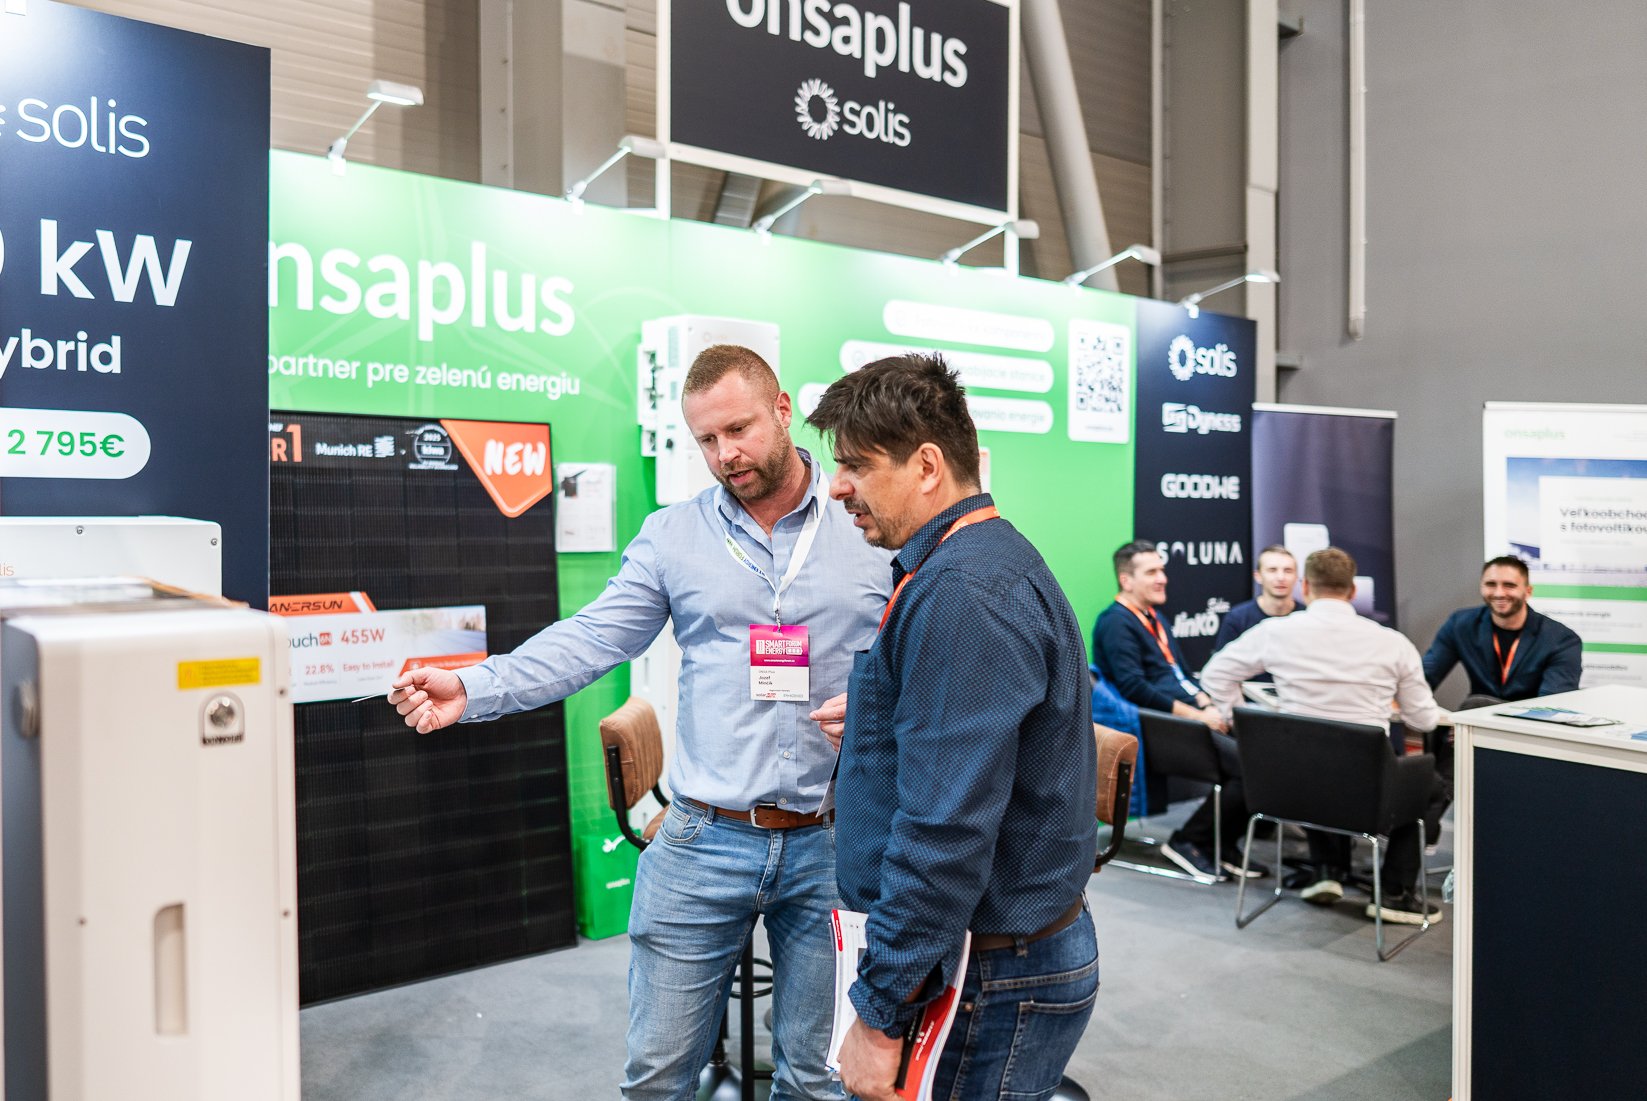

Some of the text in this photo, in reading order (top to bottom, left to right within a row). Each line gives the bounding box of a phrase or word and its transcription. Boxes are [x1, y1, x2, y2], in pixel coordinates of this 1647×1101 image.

[725, 0, 968, 88] onsaplus
[16, 96, 150, 158] solis
[842, 100, 911, 147] solis
[40, 218, 192, 307] kW
[1194, 342, 1238, 377] solis
[367, 361, 409, 388] pre
[415, 362, 491, 389] zelenú
[496, 371, 580, 400] energiu
[7, 429, 125, 458] 2 795€
[315, 442, 373, 458] Munich RE
[484, 439, 546, 476] NEW
[341, 628, 385, 645] 455W
[765, 640, 786, 648] SMART
[305, 660, 395, 675] 22.8% Easy to Install
